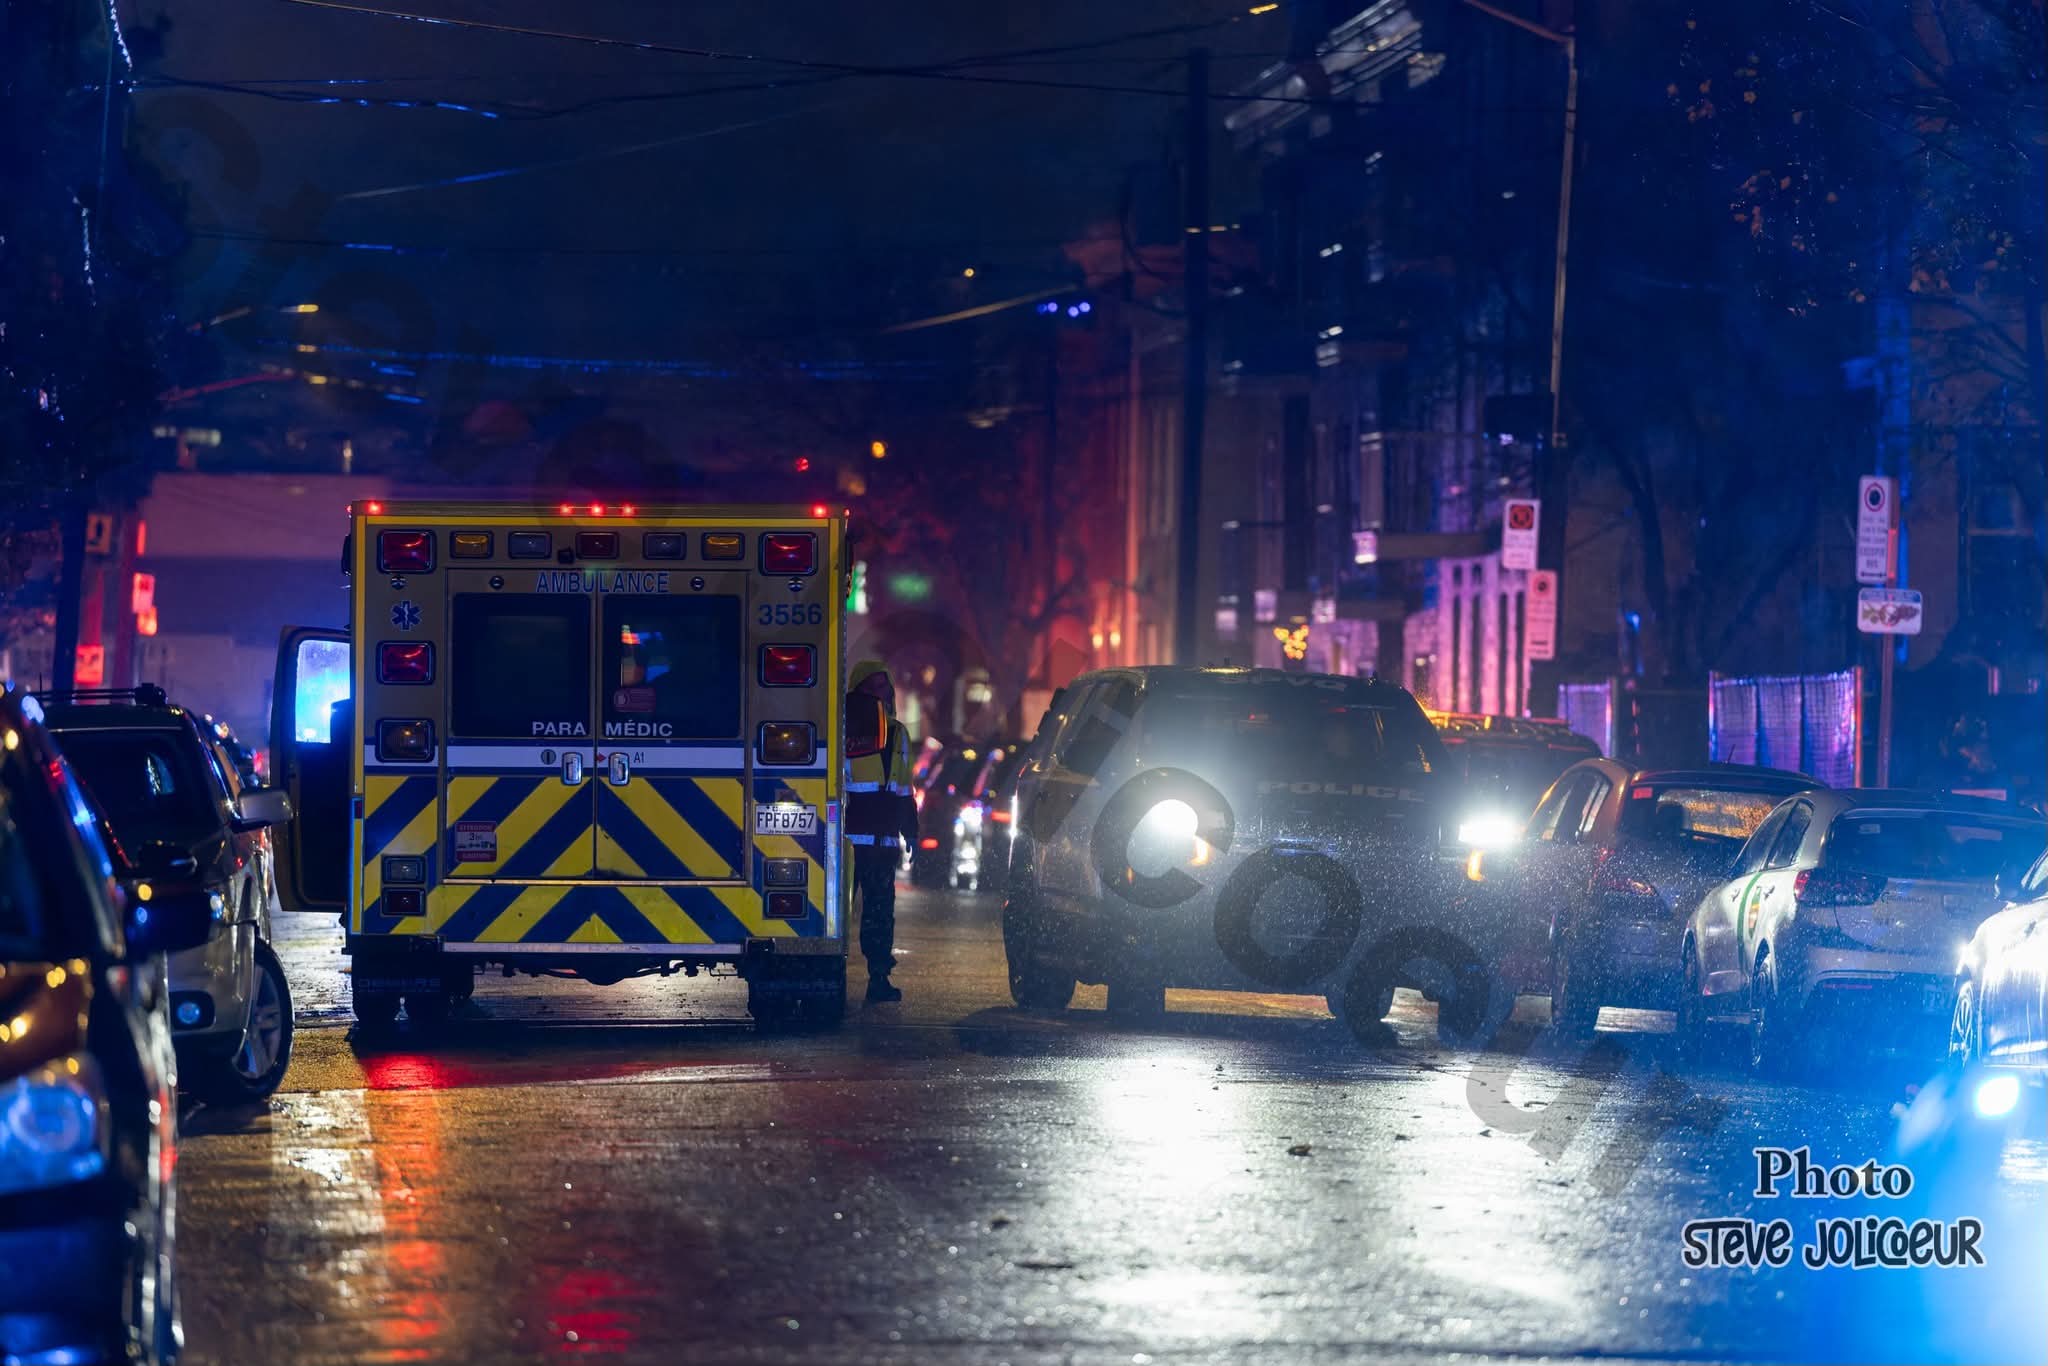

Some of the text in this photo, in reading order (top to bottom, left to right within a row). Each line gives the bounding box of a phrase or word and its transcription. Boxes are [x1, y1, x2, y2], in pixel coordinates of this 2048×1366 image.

[535, 570, 671, 593] AMBULANCE
[758, 603, 823, 626] 3556
[532, 719, 673, 737] PARA MÉDIC
[1257, 782, 1425, 801] POLICE
[757, 811, 814, 829] FPF8757
